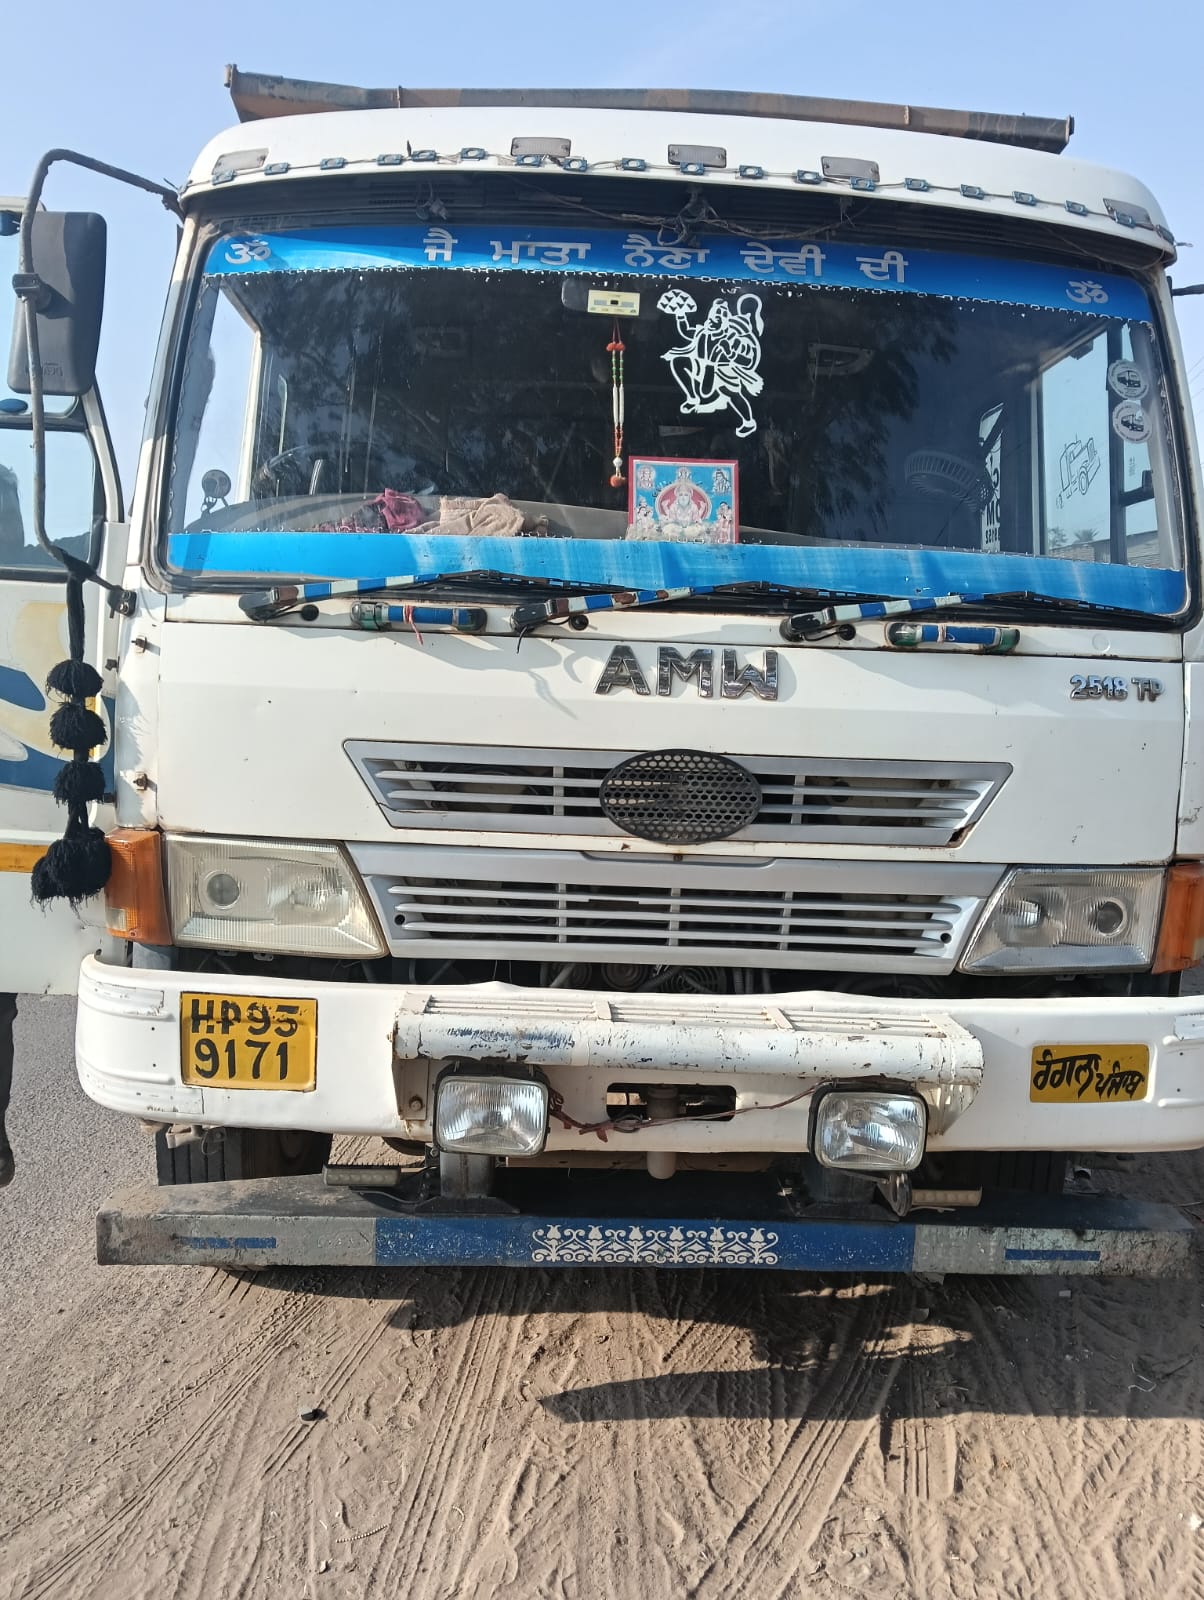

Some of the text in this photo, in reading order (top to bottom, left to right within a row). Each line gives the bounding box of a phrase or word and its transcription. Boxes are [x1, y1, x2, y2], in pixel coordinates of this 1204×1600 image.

[423, 227, 458, 262] ਜੈ
[490, 240, 592, 266] ਮਾਤਾ
[739, 242, 827, 277] ਦੇਵੀ
[856, 250, 909, 283] ਦੀ
[594, 644, 779, 701] AMW
[1069, 674, 1166, 703] 2518 TP
[194, 1037, 289, 1081] 9171
